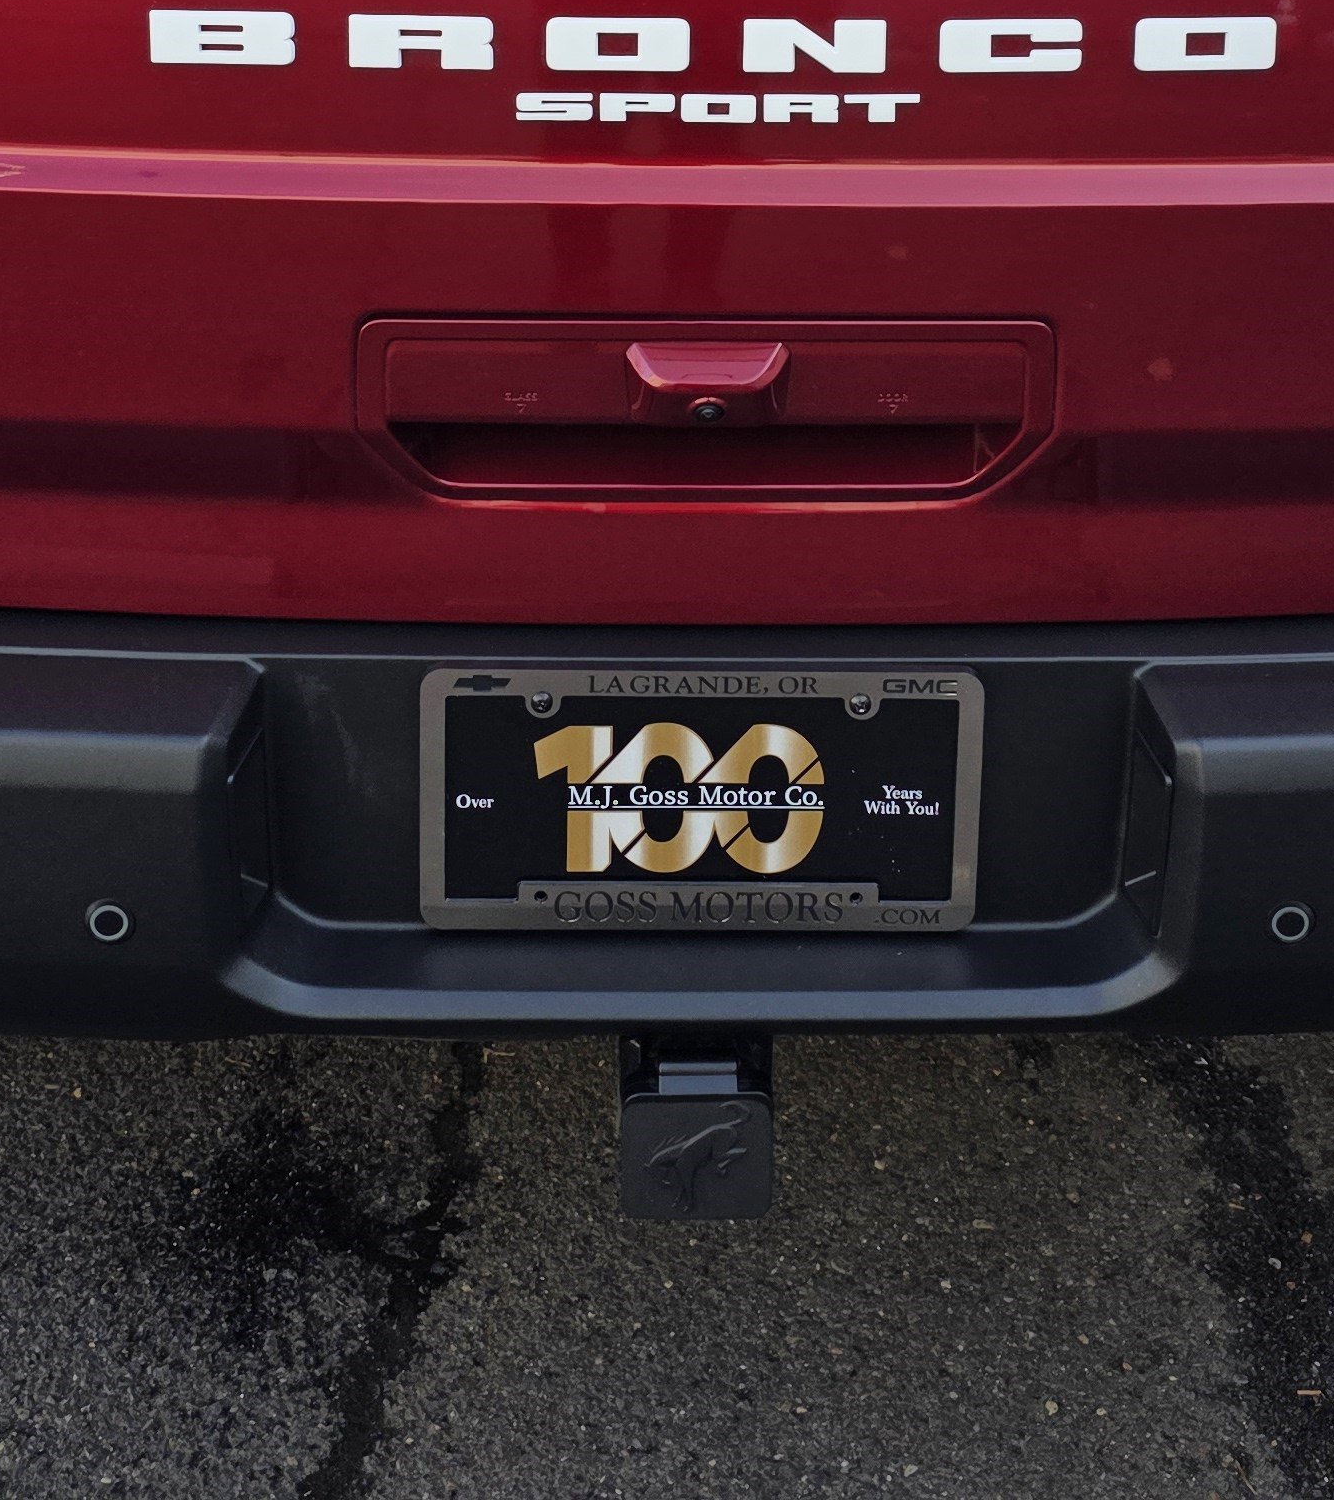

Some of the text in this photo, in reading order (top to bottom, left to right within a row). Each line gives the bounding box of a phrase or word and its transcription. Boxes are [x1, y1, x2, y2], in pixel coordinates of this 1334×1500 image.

[148, 8, 1279, 74] BRONCO
[514, 91, 921, 124] SPORT
[777, 676, 820, 695] OR
[882, 678, 959, 696] GMC
[567, 785, 825, 809] M.J. Goss Motor Co.
[881, 784, 923, 800] Years
[455, 793, 495, 811] Over
[863, 800, 940, 816] With You!
[553, 891, 844, 924] GOSS MOTORS
